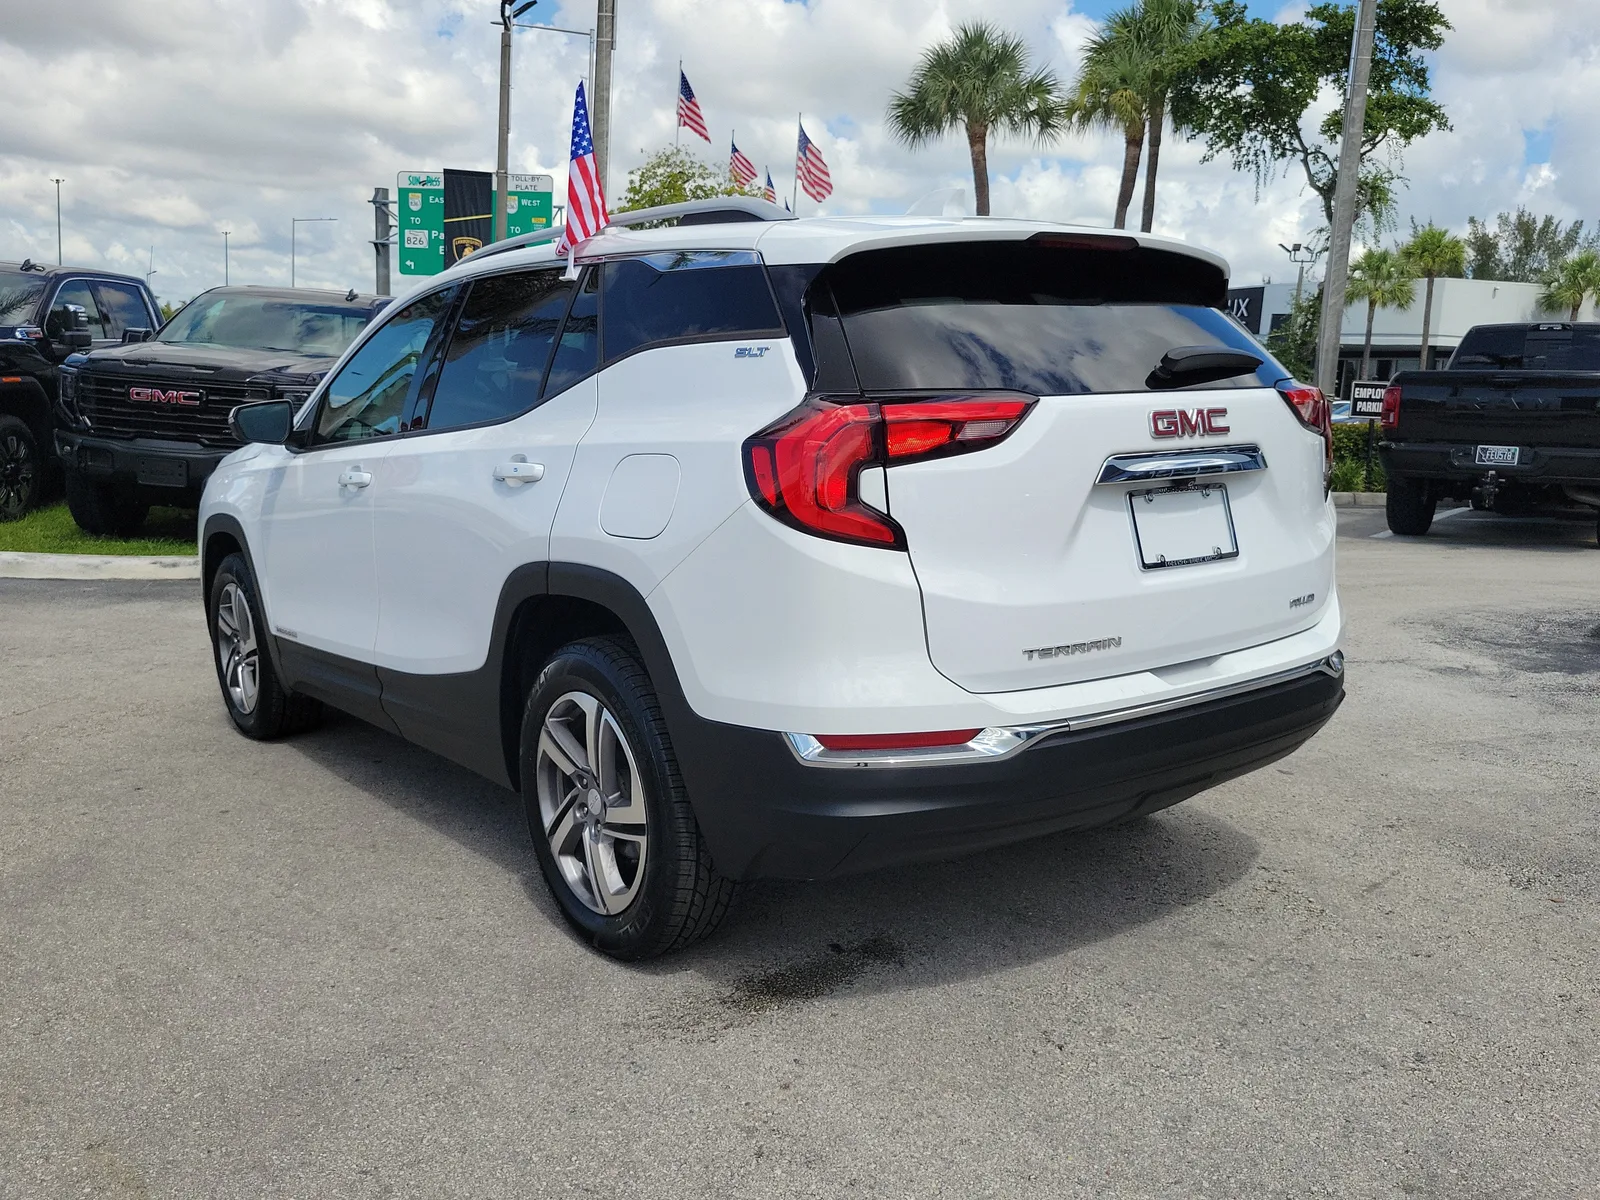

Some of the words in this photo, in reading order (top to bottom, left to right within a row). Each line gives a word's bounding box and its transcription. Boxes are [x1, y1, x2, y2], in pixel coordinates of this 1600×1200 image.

[429, 196, 444, 204] EAS
[521, 198, 541, 207] WEST
[410, 217, 421, 225] TO
[431, 231, 444, 240] Pa
[510, 226, 521, 234] TO
[406, 236, 424, 246] 826
[734, 346, 771, 358] SLT
[129, 387, 201, 406] GMC
[1354, 387, 1386, 399] EMPLOY
[1356, 401, 1383, 413] PARKI
[1149, 407, 1231, 439] GMC
[1289, 593, 1315, 609] AWD
[1022, 636, 1122, 661] TERRAIN
